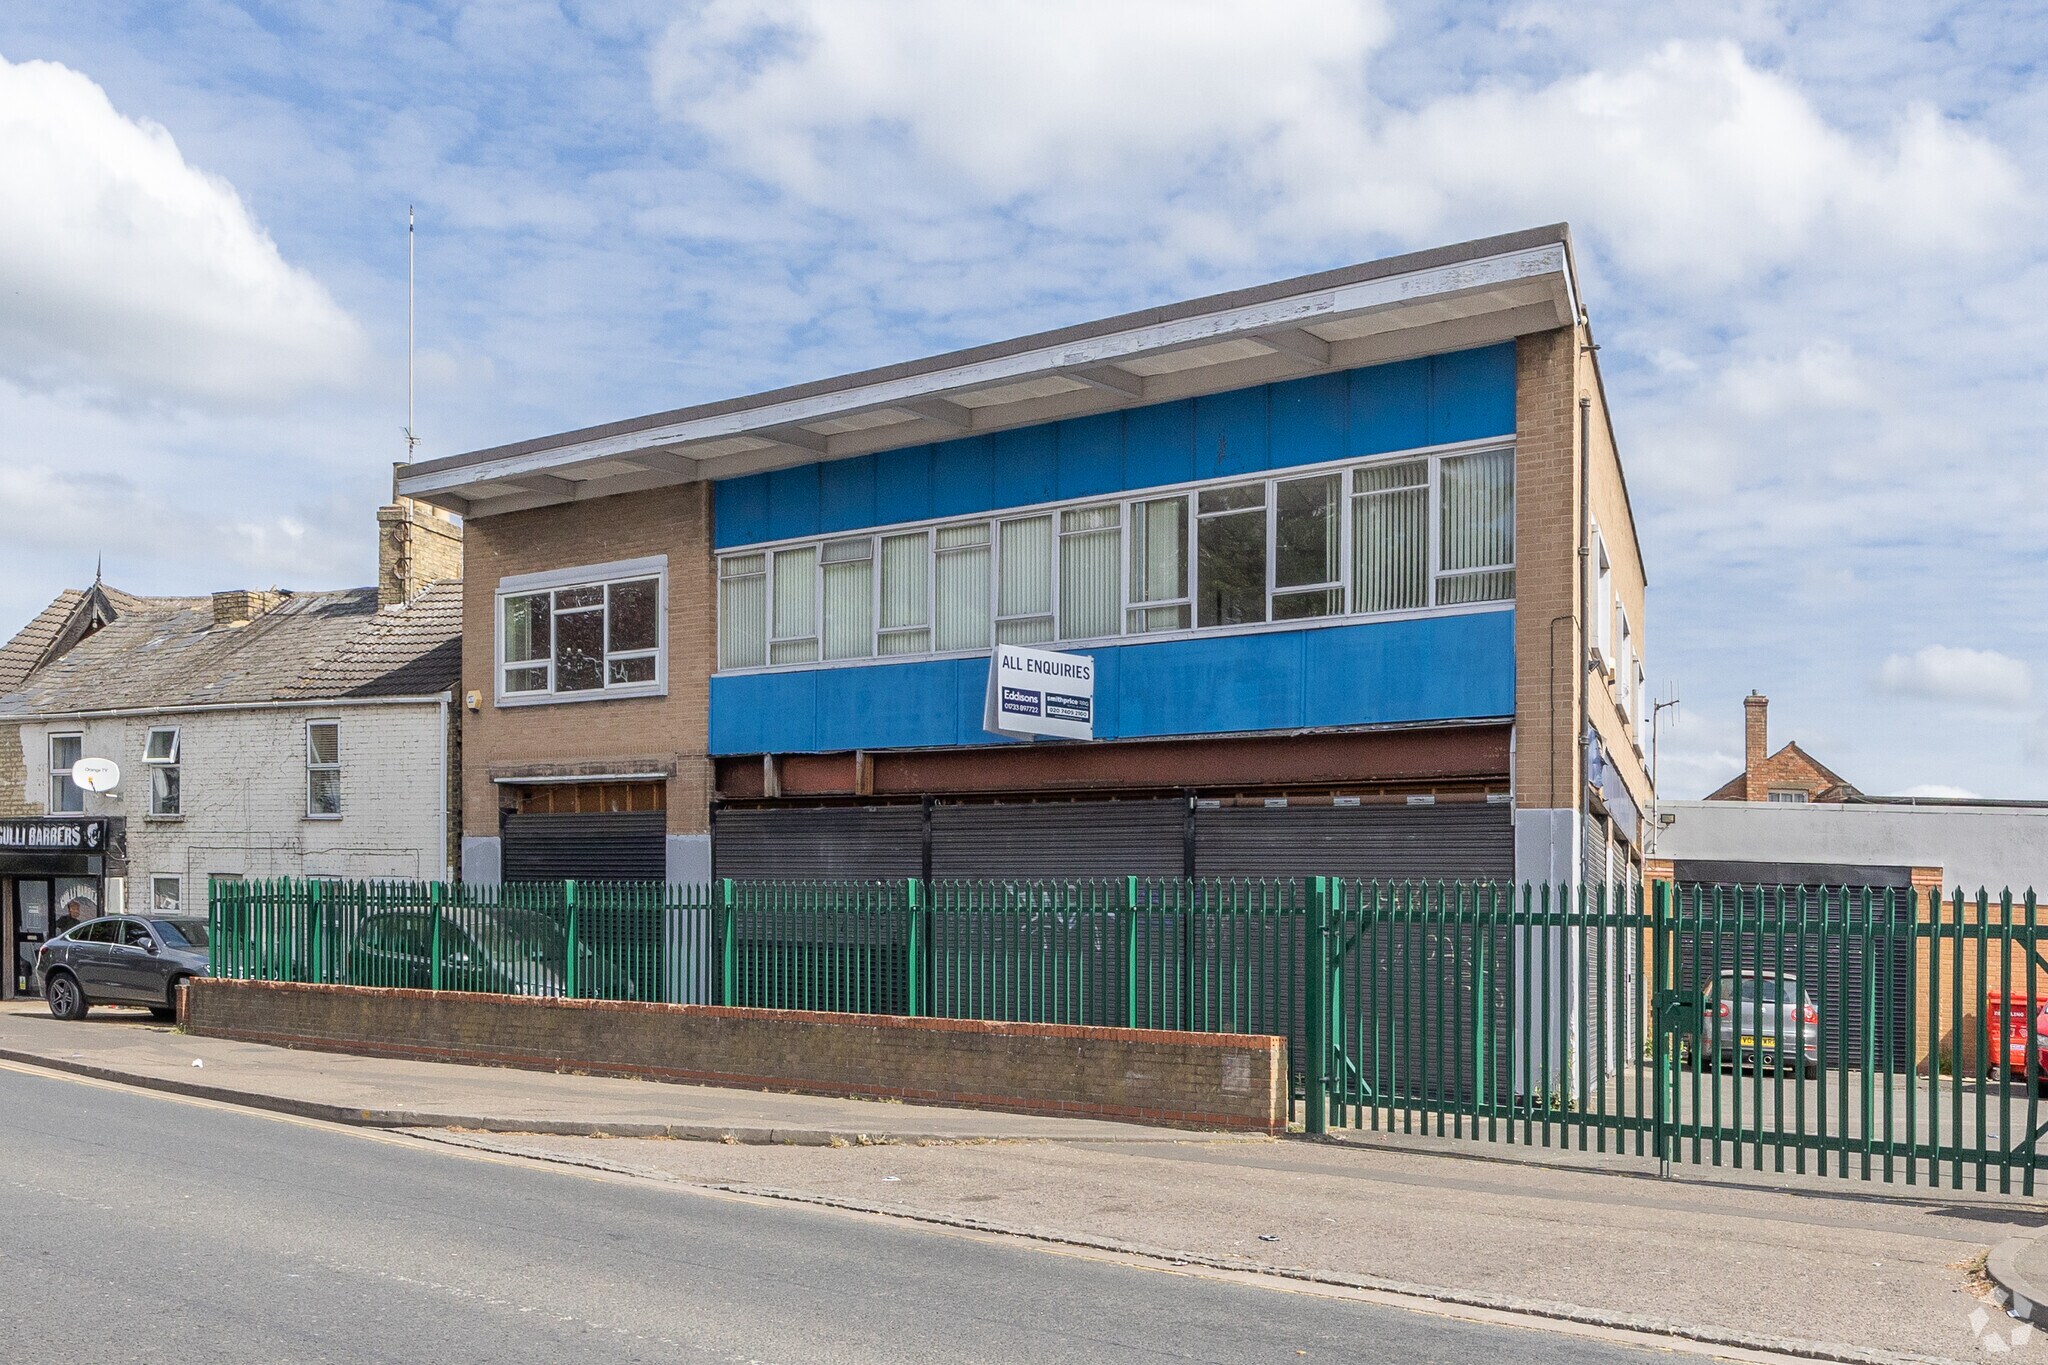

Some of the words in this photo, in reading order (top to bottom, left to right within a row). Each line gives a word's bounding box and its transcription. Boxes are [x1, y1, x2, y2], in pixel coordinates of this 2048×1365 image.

[1002, 655, 1023, 671] ALL
[1027, 659, 1090, 680] ENQUIRIES
[1004, 690, 1038, 703] Eddisons
[28, 825, 80, 846] BARBERS
